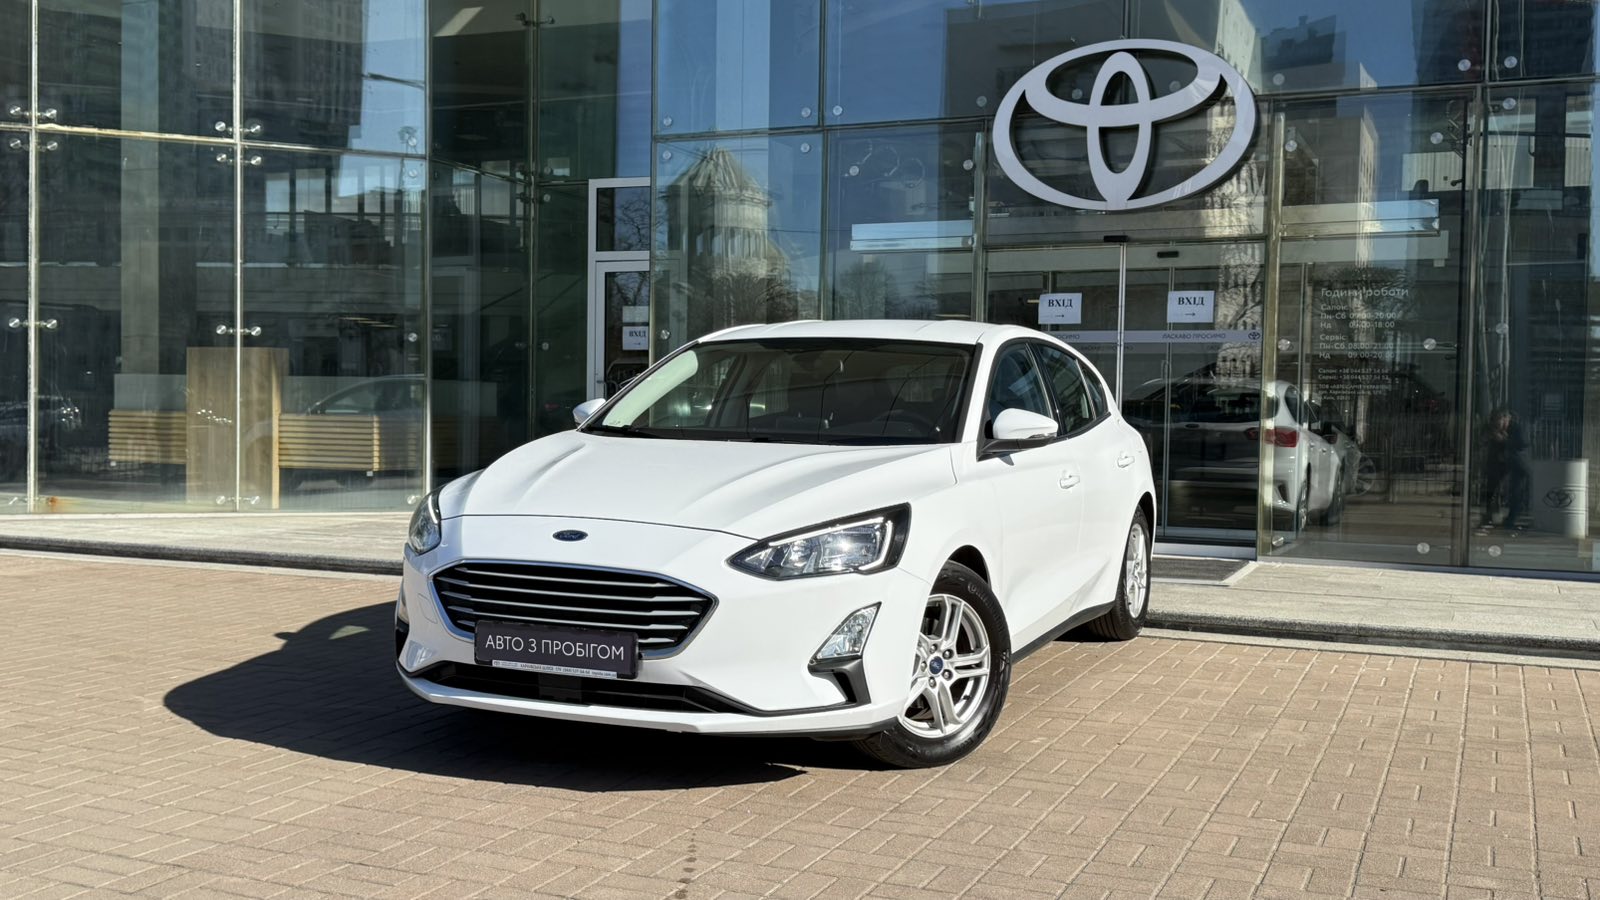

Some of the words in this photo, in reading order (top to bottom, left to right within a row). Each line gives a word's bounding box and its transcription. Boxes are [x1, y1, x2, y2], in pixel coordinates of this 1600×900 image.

[1366, 287, 1409, 297] роботи
[1048, 298, 1073, 308] ВХІД
[1177, 296, 1205, 306] ВХІД
[1320, 312, 1347, 320] Пн-Сб
[1320, 321, 1332, 330] Нд
[1319, 342, 1345, 350] Пн-Сб
[1319, 352, 1331, 360] Нд
[485, 634, 524, 652] АВТО
[528, 638, 537, 653] З
[541, 639, 625, 661] ПРОБІГОМ
